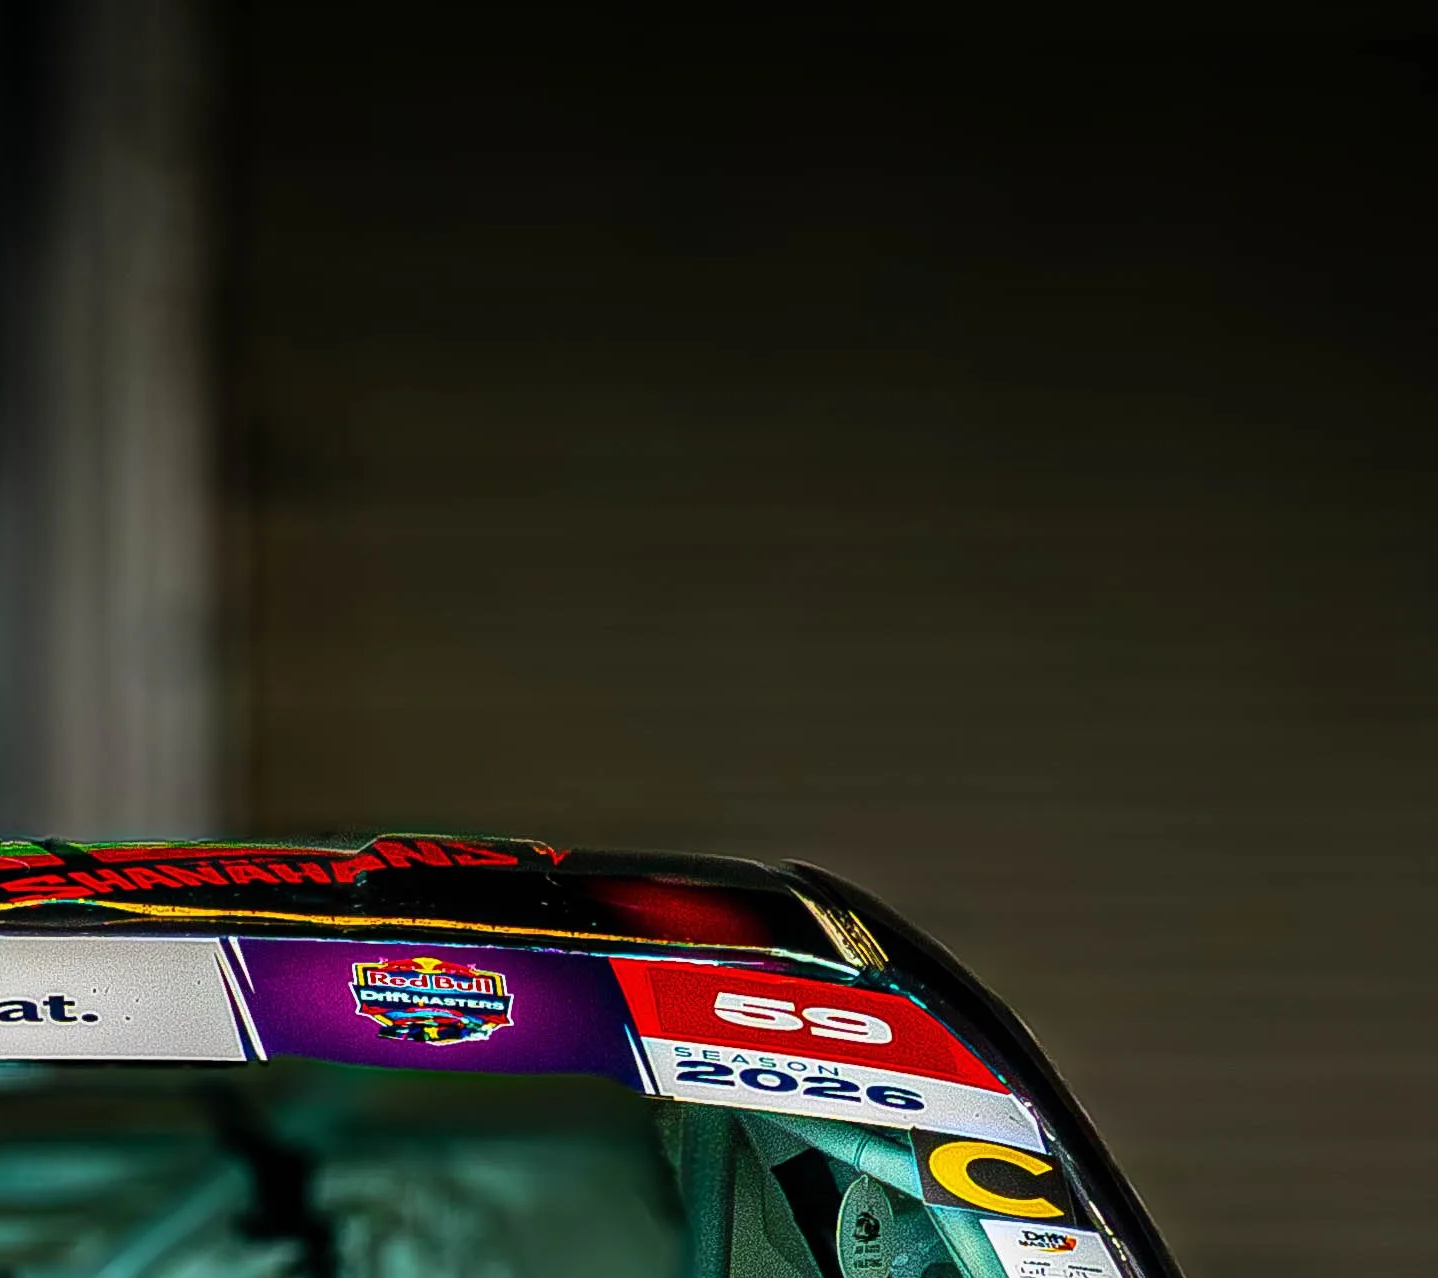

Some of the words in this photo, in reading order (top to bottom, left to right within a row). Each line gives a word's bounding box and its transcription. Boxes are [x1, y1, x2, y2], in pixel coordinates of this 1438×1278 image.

[360, 989, 411, 1004] Drift
[412, 995, 505, 1011] MASTERS
[368, 971, 429, 988] Red
[434, 976, 493, 994] Bull
[713, 991, 893, 1045] 59
[674, 1046, 841, 1077] SEASON
[675, 1060, 926, 1112] 2026
[929, 1141, 1065, 1219] C
